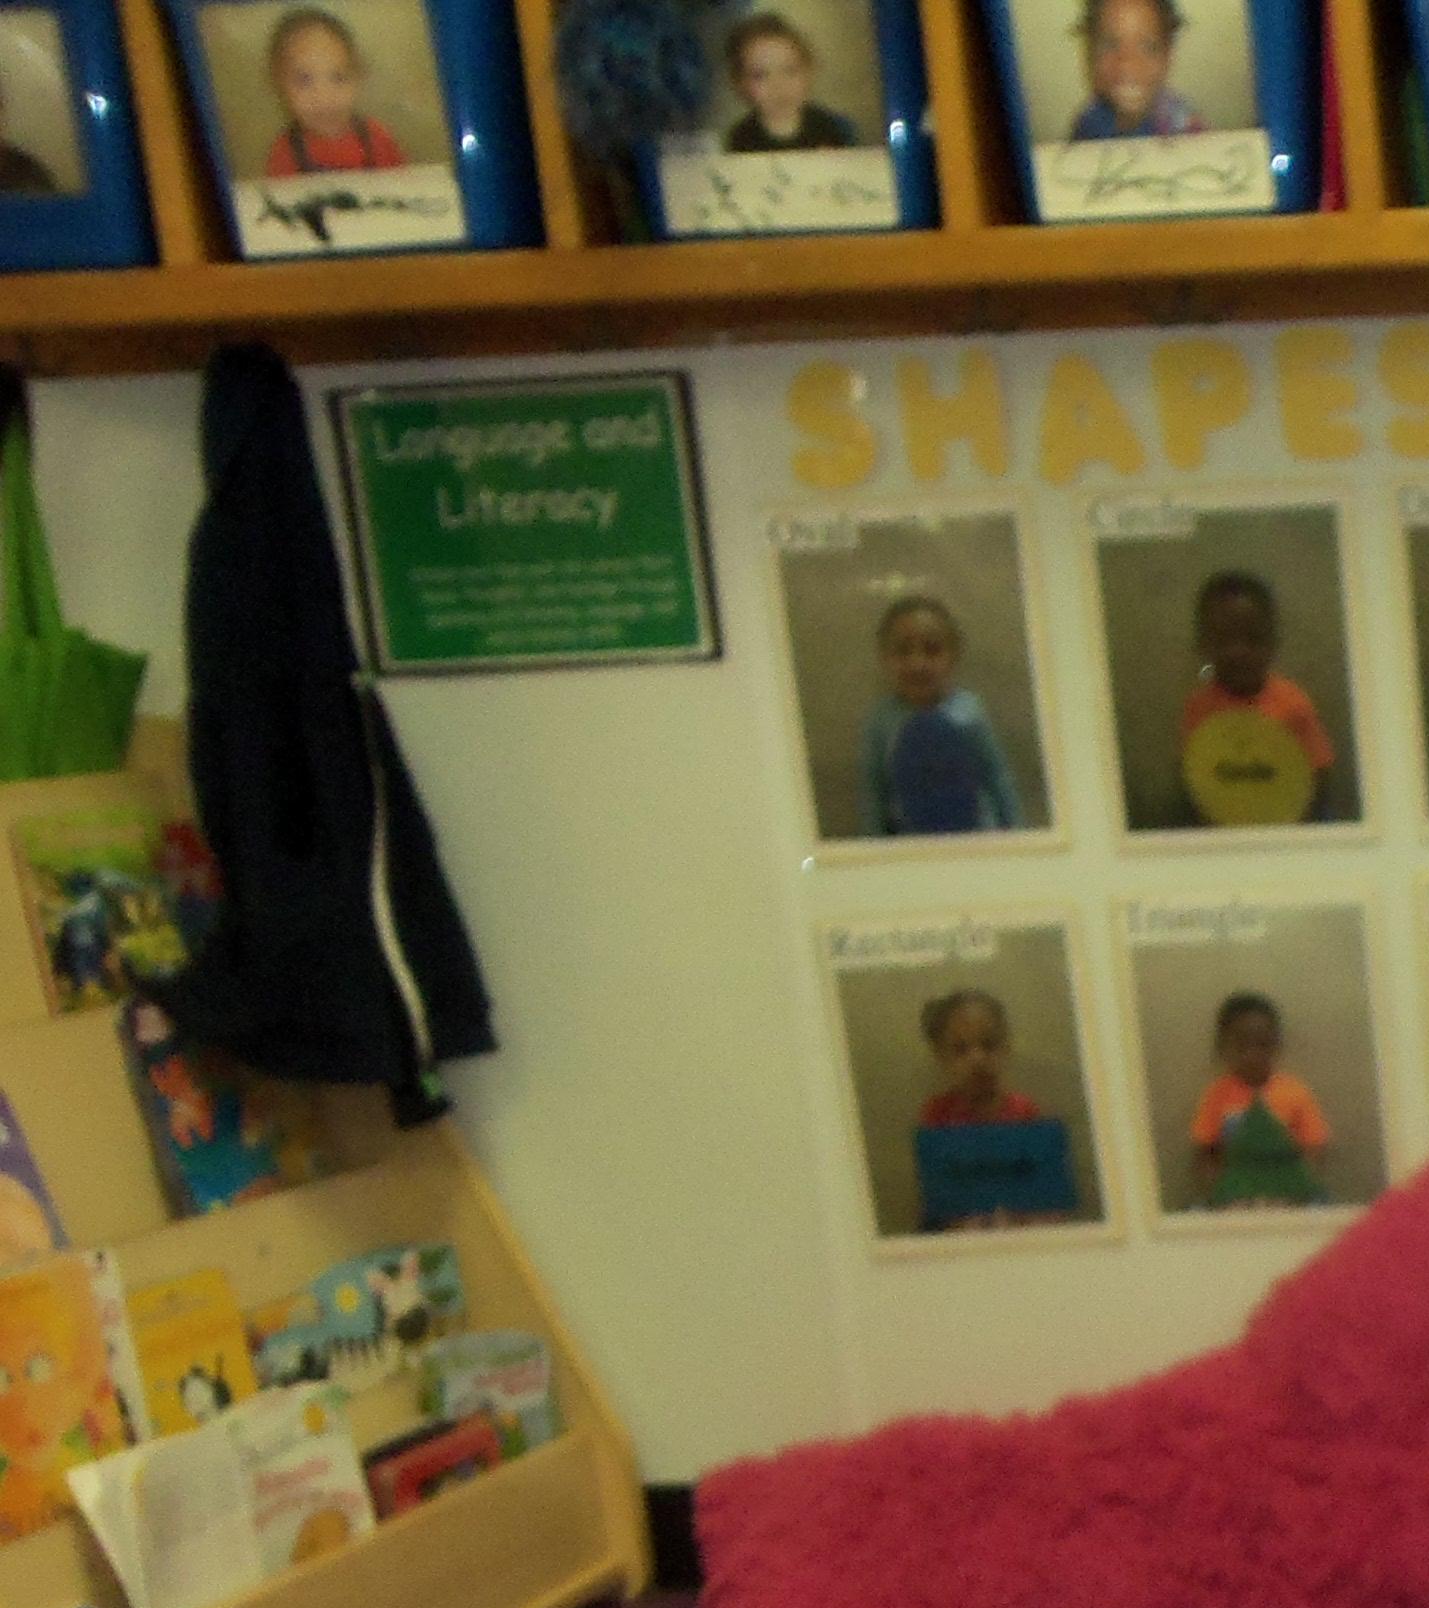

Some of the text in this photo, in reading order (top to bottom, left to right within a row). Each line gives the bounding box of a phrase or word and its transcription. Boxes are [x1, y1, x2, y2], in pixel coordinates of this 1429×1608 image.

[371, 402, 662, 471] Language and
[434, 484, 619, 533] Literacy
